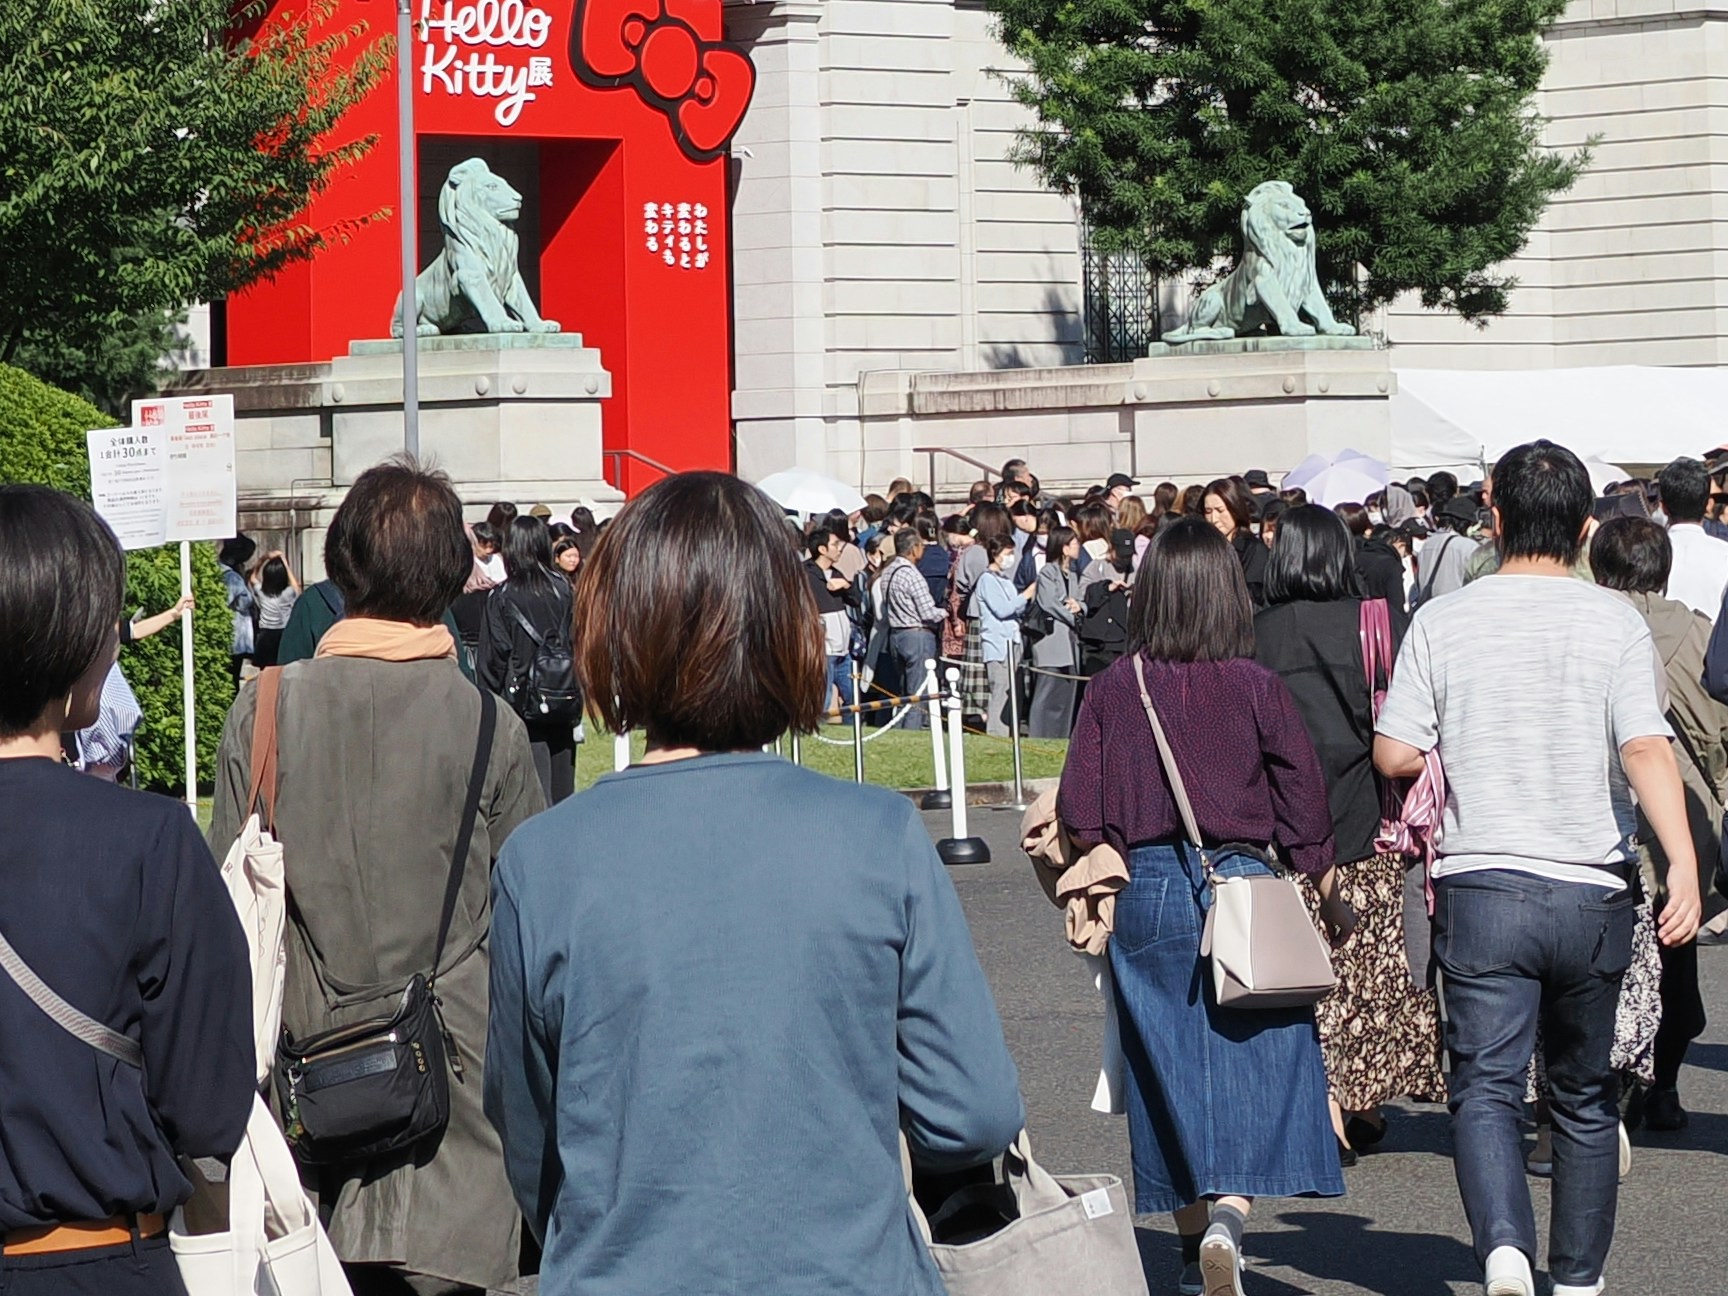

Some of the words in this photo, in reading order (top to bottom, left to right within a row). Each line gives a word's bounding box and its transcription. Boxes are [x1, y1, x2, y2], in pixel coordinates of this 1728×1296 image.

[643, 202, 659, 252] 変わる
[661, 202, 676, 266] キティも
[677, 202, 692, 269] 変わると
[693, 202, 710, 269] わたしが
